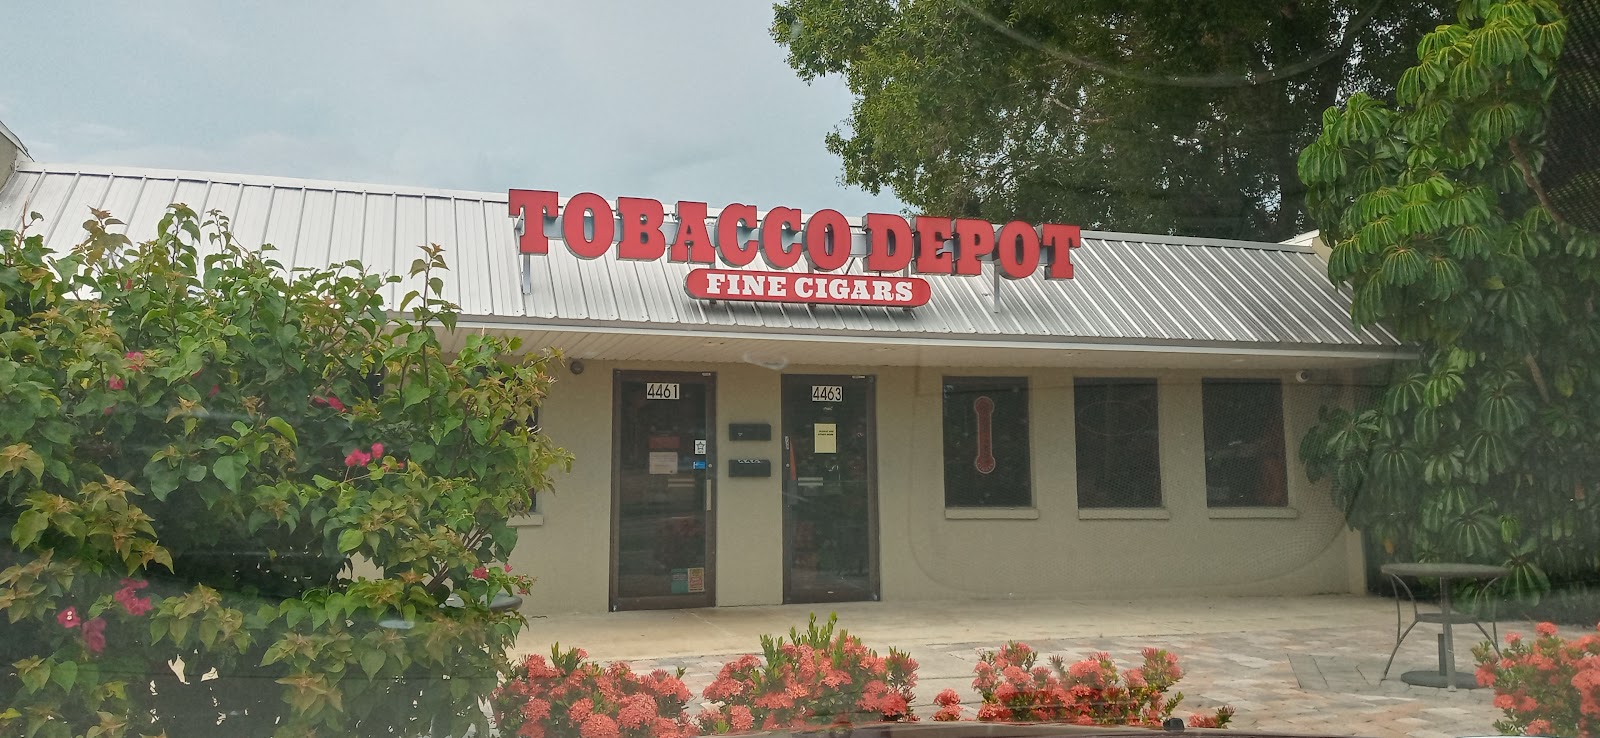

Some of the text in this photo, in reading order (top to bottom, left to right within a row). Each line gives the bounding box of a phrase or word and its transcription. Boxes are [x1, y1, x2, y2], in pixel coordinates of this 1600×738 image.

[508, 188, 1080, 280] TOBACCO DEPOT
[706, 273, 913, 302] FINE CIGARS
[647, 384, 678, 398] 4461
[813, 387, 841, 401] 4463
